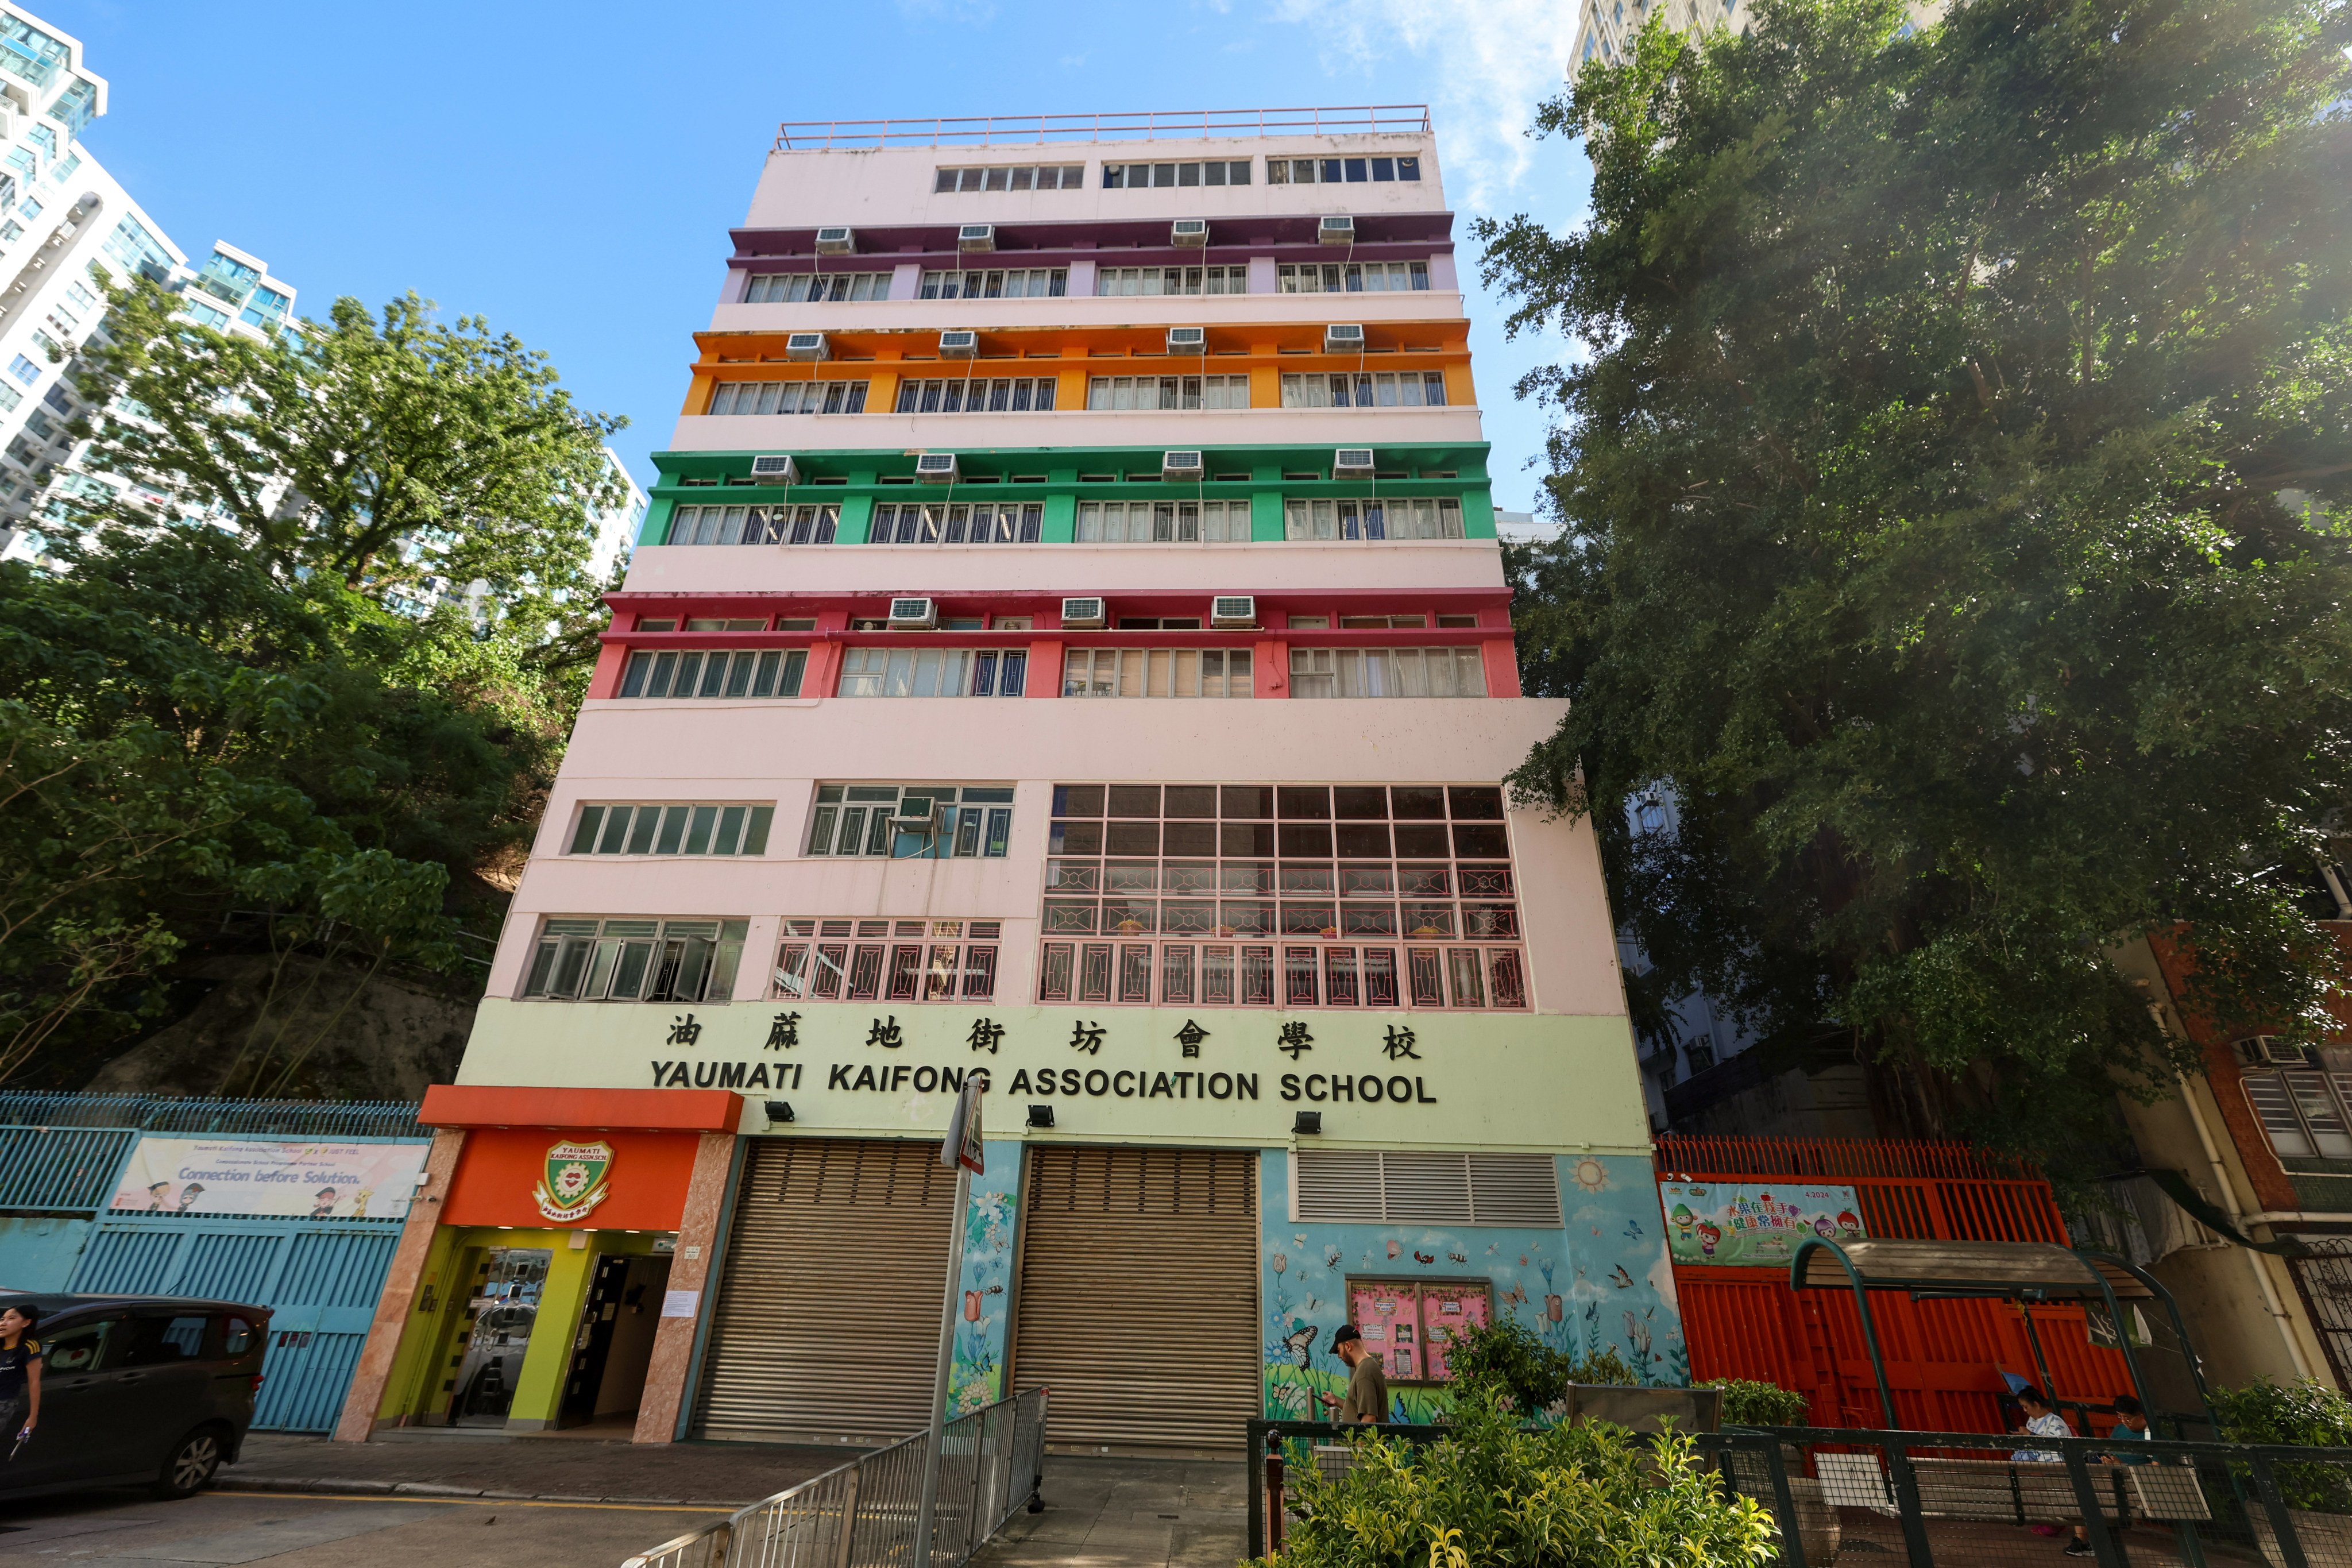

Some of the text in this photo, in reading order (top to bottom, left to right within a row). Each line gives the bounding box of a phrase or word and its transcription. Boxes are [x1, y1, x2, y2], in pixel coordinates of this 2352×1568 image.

[651, 1061, 1436, 1103] YAUMATI KAIFONG ASSOCIATION SCHOOL
[178, 1167, 361, 1185] Connection before Solution.
[1727, 1201, 1789, 1218] 水果在我手
[1733, 1215, 1796, 1231] 健康常擁有
